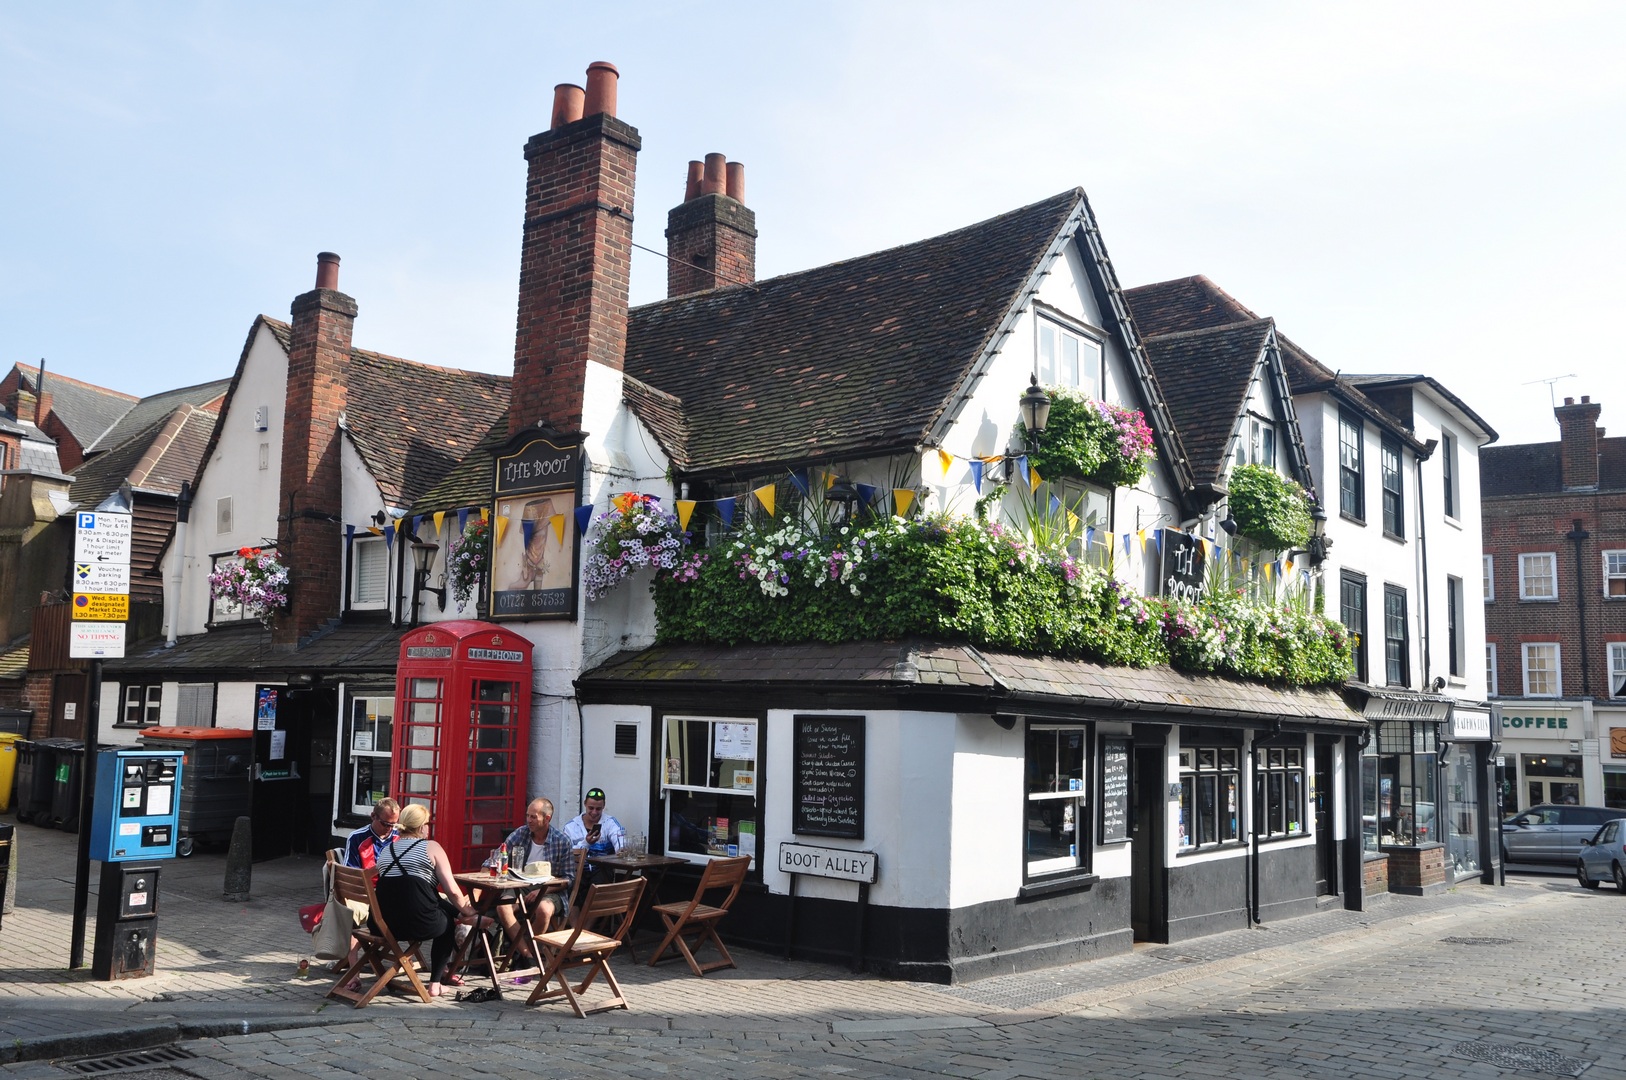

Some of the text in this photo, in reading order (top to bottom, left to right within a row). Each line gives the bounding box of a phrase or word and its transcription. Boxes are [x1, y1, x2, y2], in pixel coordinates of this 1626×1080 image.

[504, 454, 570, 482] THE BOOT
[82, 514, 93, 528] P
[1168, 575, 1204, 605] BOOT
[500, 592, 565, 608] 01727 857533
[471, 648, 519, 661] TELEPHONE
[1502, 717, 1568, 729] COFFEE
[785, 852, 867, 874] BOOT ALLEY
